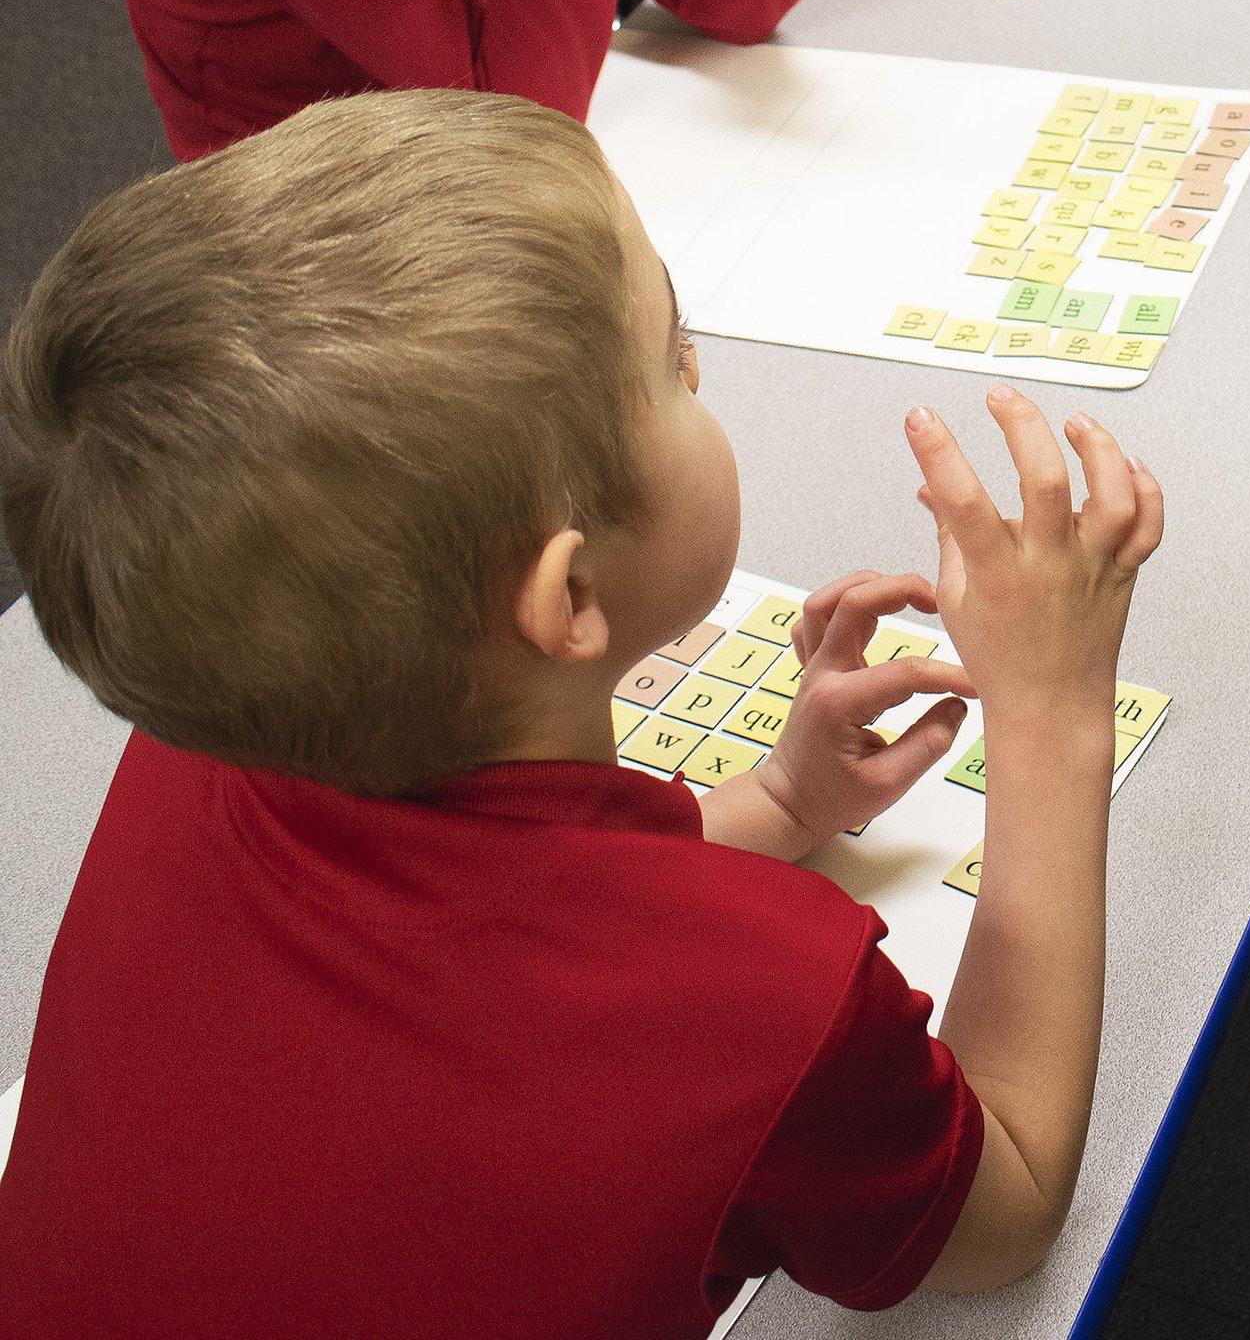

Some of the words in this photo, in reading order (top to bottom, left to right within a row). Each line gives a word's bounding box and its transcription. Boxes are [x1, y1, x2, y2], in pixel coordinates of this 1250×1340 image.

[1053, 201, 1078, 221] qu
[1013, 286, 1039, 311] am
[1062, 298, 1085, 318] an
[899, 311, 927, 331] ch
[1134, 303, 1161, 323] all
[952, 324, 980, 343] ck
[1008, 332, 1033, 349] th
[1065, 336, 1091, 355] sh
[1115, 340, 1143, 362] wh
[770, 611, 796, 628] d
[730, 650, 756, 670] j
[635, 676, 655, 690] o
[686, 693, 713, 711] p
[1114, 698, 1143, 722] th
[743, 709, 784, 733] qu
[655, 731, 683, 750] w
[705, 756, 732, 775] x
